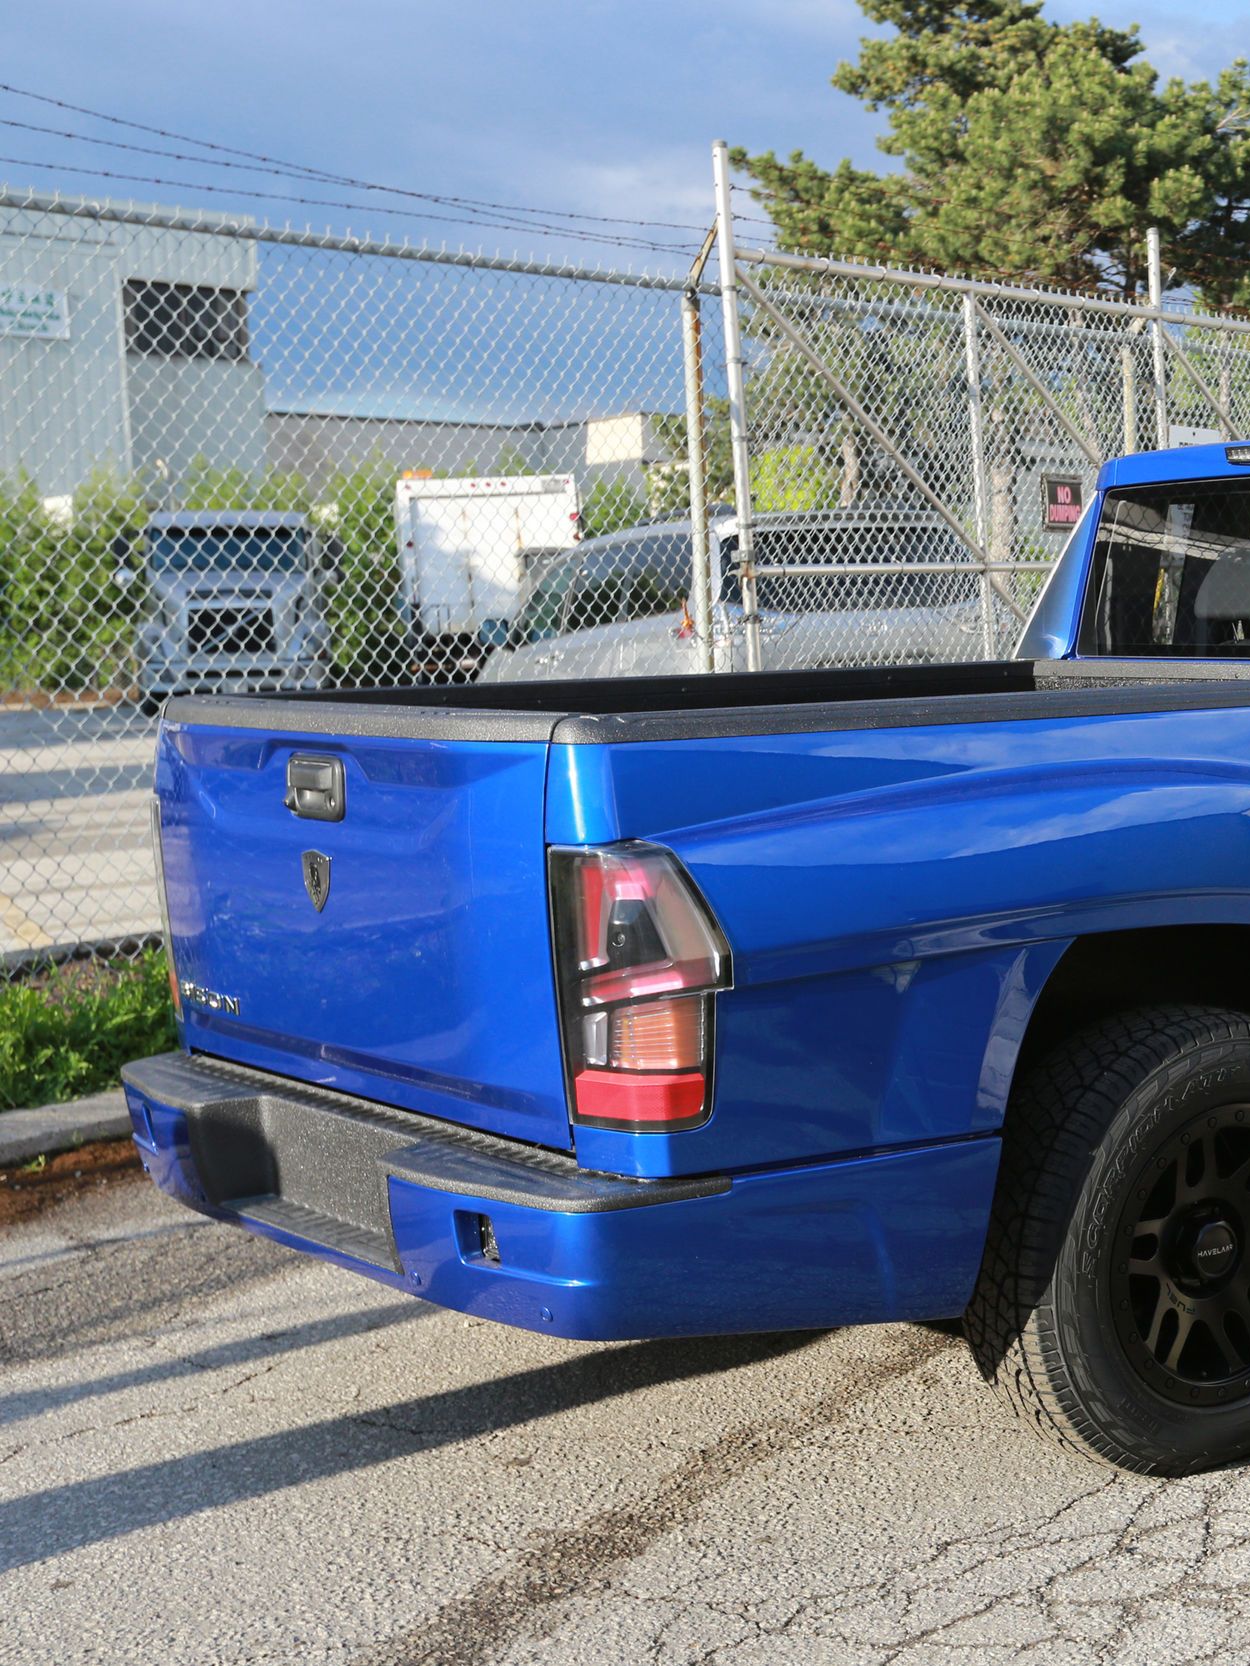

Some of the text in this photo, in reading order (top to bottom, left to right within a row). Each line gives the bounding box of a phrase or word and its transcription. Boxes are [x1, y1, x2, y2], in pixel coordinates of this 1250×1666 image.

[1056, 485, 1072, 504] NO
[1049, 503, 1081, 522] DUMPING
[1197, 1243, 1233, 1257] HAVELAAR
